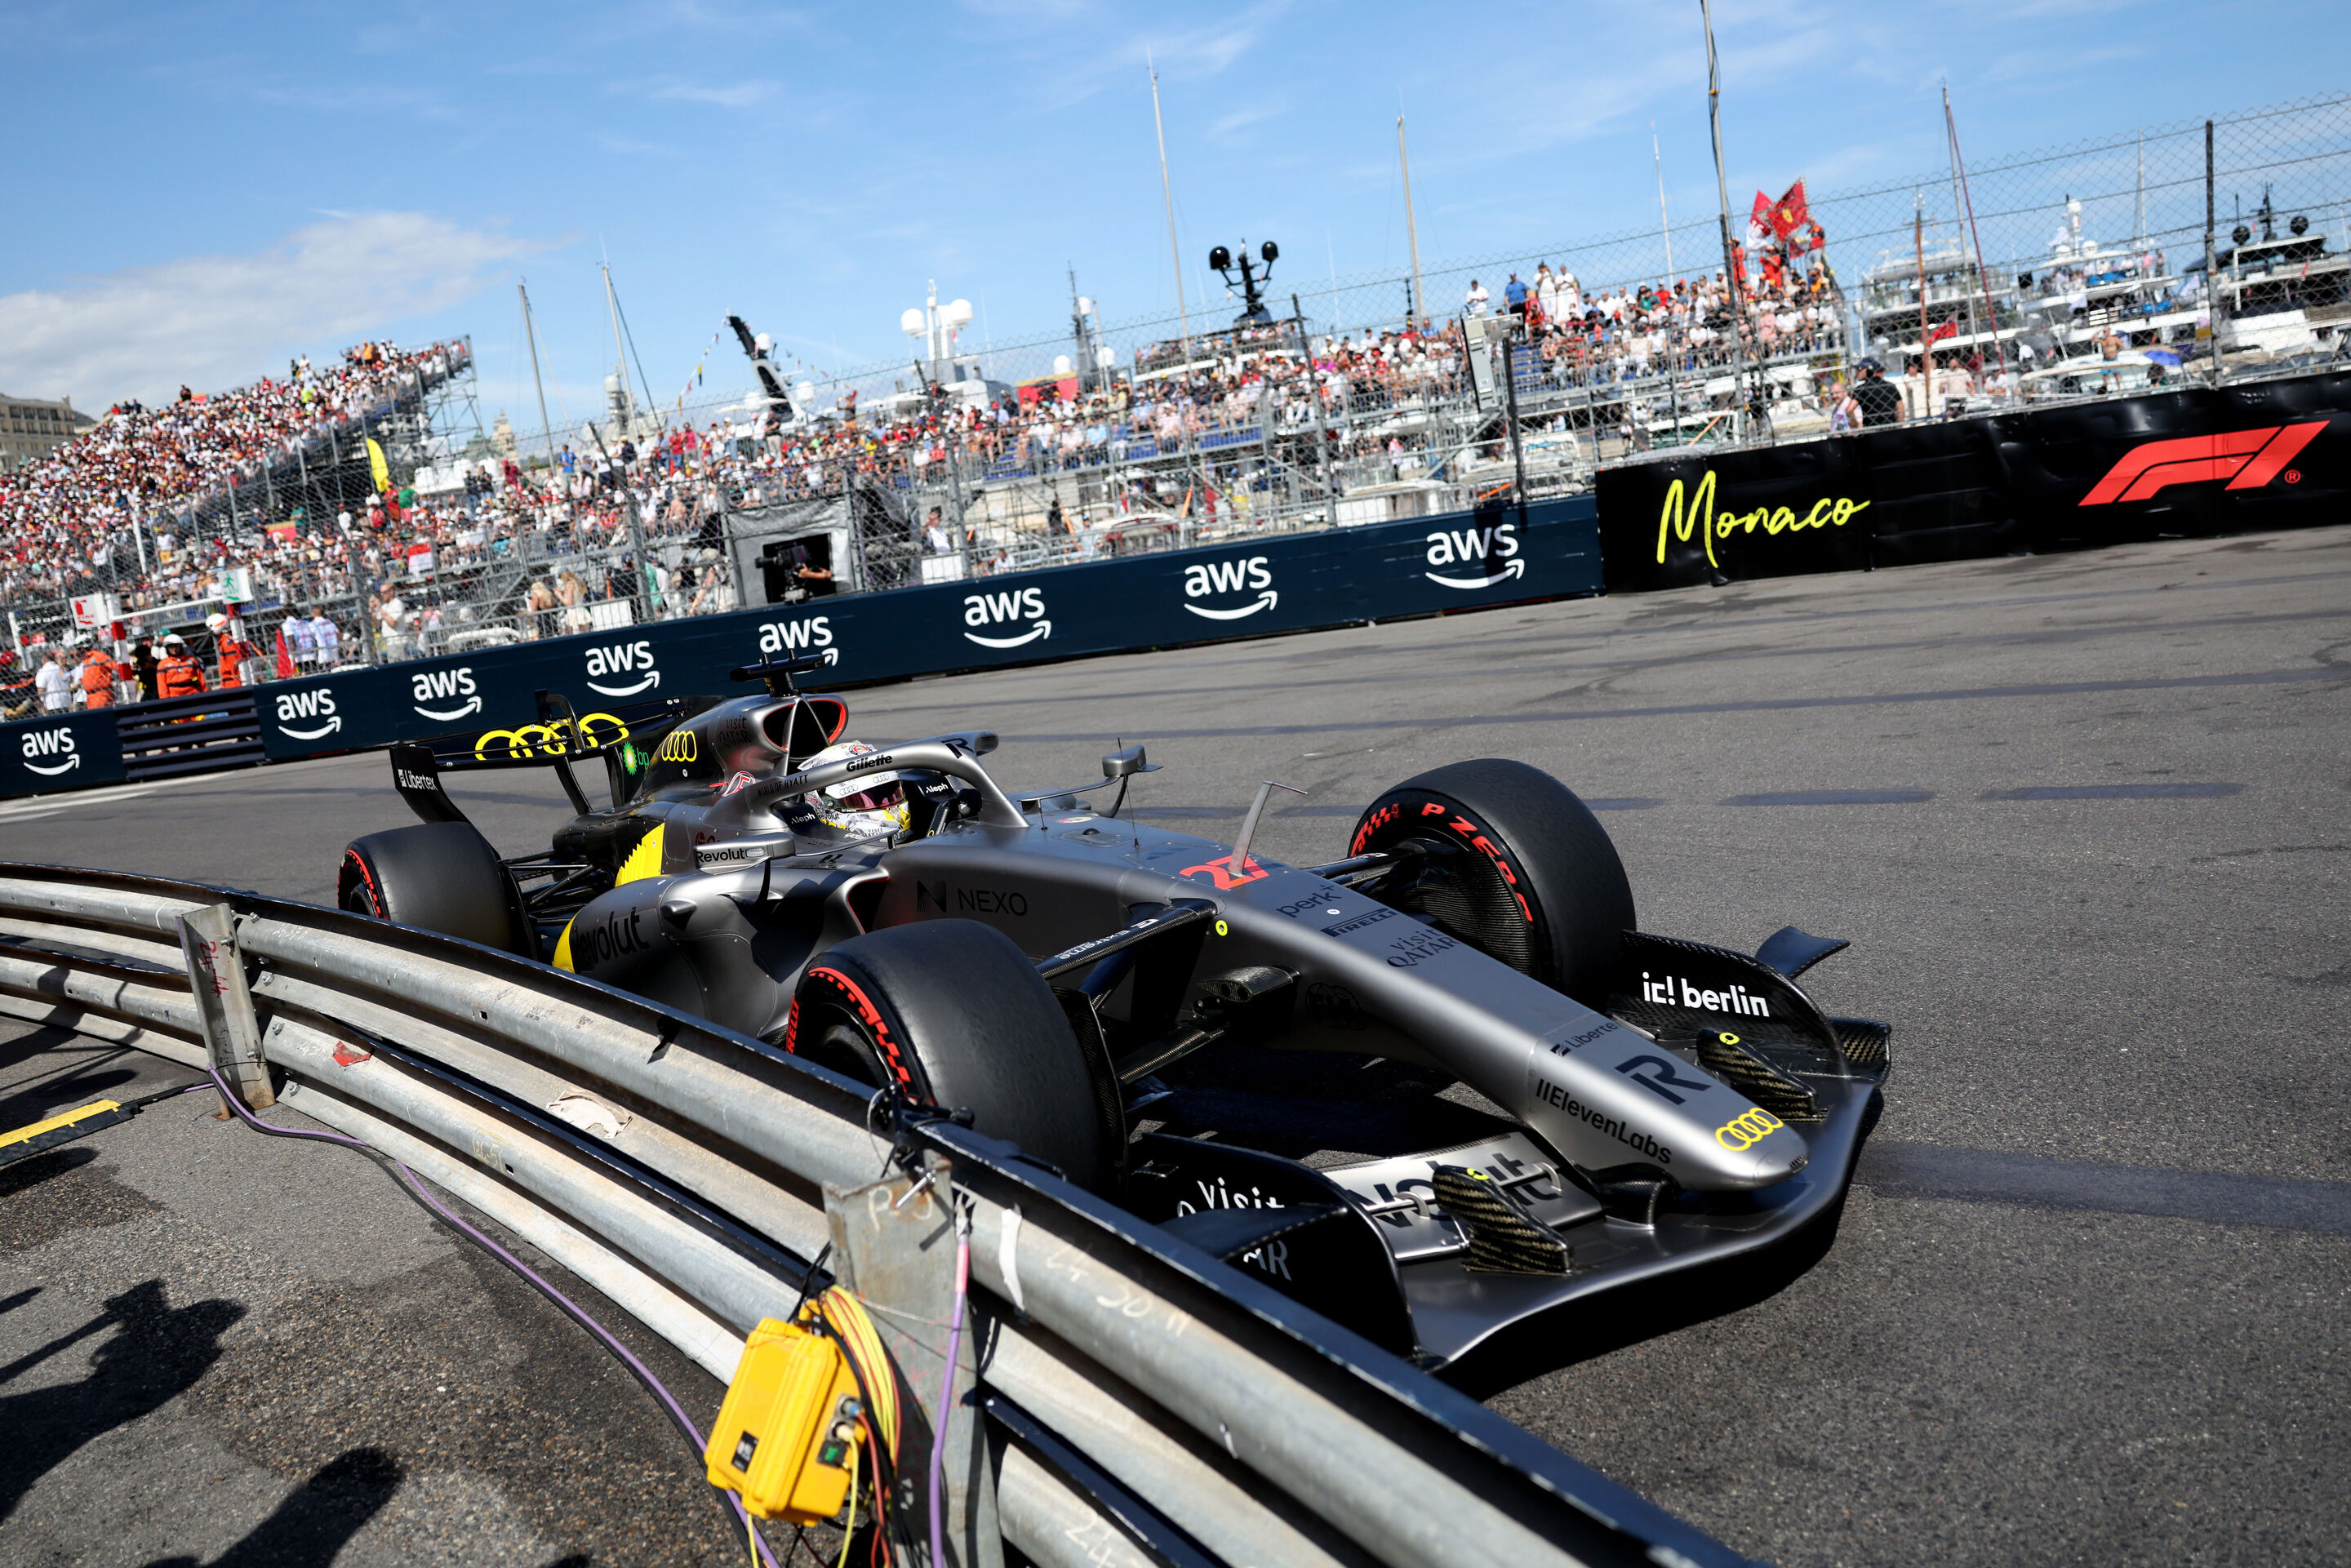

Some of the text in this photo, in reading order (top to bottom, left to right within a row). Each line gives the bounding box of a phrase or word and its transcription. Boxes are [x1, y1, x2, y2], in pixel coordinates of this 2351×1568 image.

[2079, 420, 2331, 506] F1
[1655, 469, 1871, 568] Monaco
[1426, 523, 1519, 566] aws
[1184, 556, 1272, 597] aws
[964, 587, 1046, 627] aws
[758, 616, 833, 654] aws
[584, 641, 655, 677] aws
[411, 667, 477, 702] aws
[276, 688, 336, 721] aws
[21, 727, 75, 758] aws
[719, 730, 752, 748] QATAR
[637, 747, 650, 771] bp
[846, 754, 893, 772] Gillette
[405, 771, 438, 791] Libertex
[775, 781, 783, 791] OF
[784, 774, 809, 788] HYATT
[926, 782, 949, 794] Aleph
[790, 812, 816, 824] Aleph
[696, 848, 746, 864] Revolut
[958, 888, 1028, 917] NEXO
[1320, 907, 1398, 938] PIRELLI
[1386, 936, 1460, 968] QATAR
[1390, 928, 1441, 951] visit
[1642, 971, 1770, 1018] ic! berlin
[1563, 1022, 1620, 1049] Liberte
